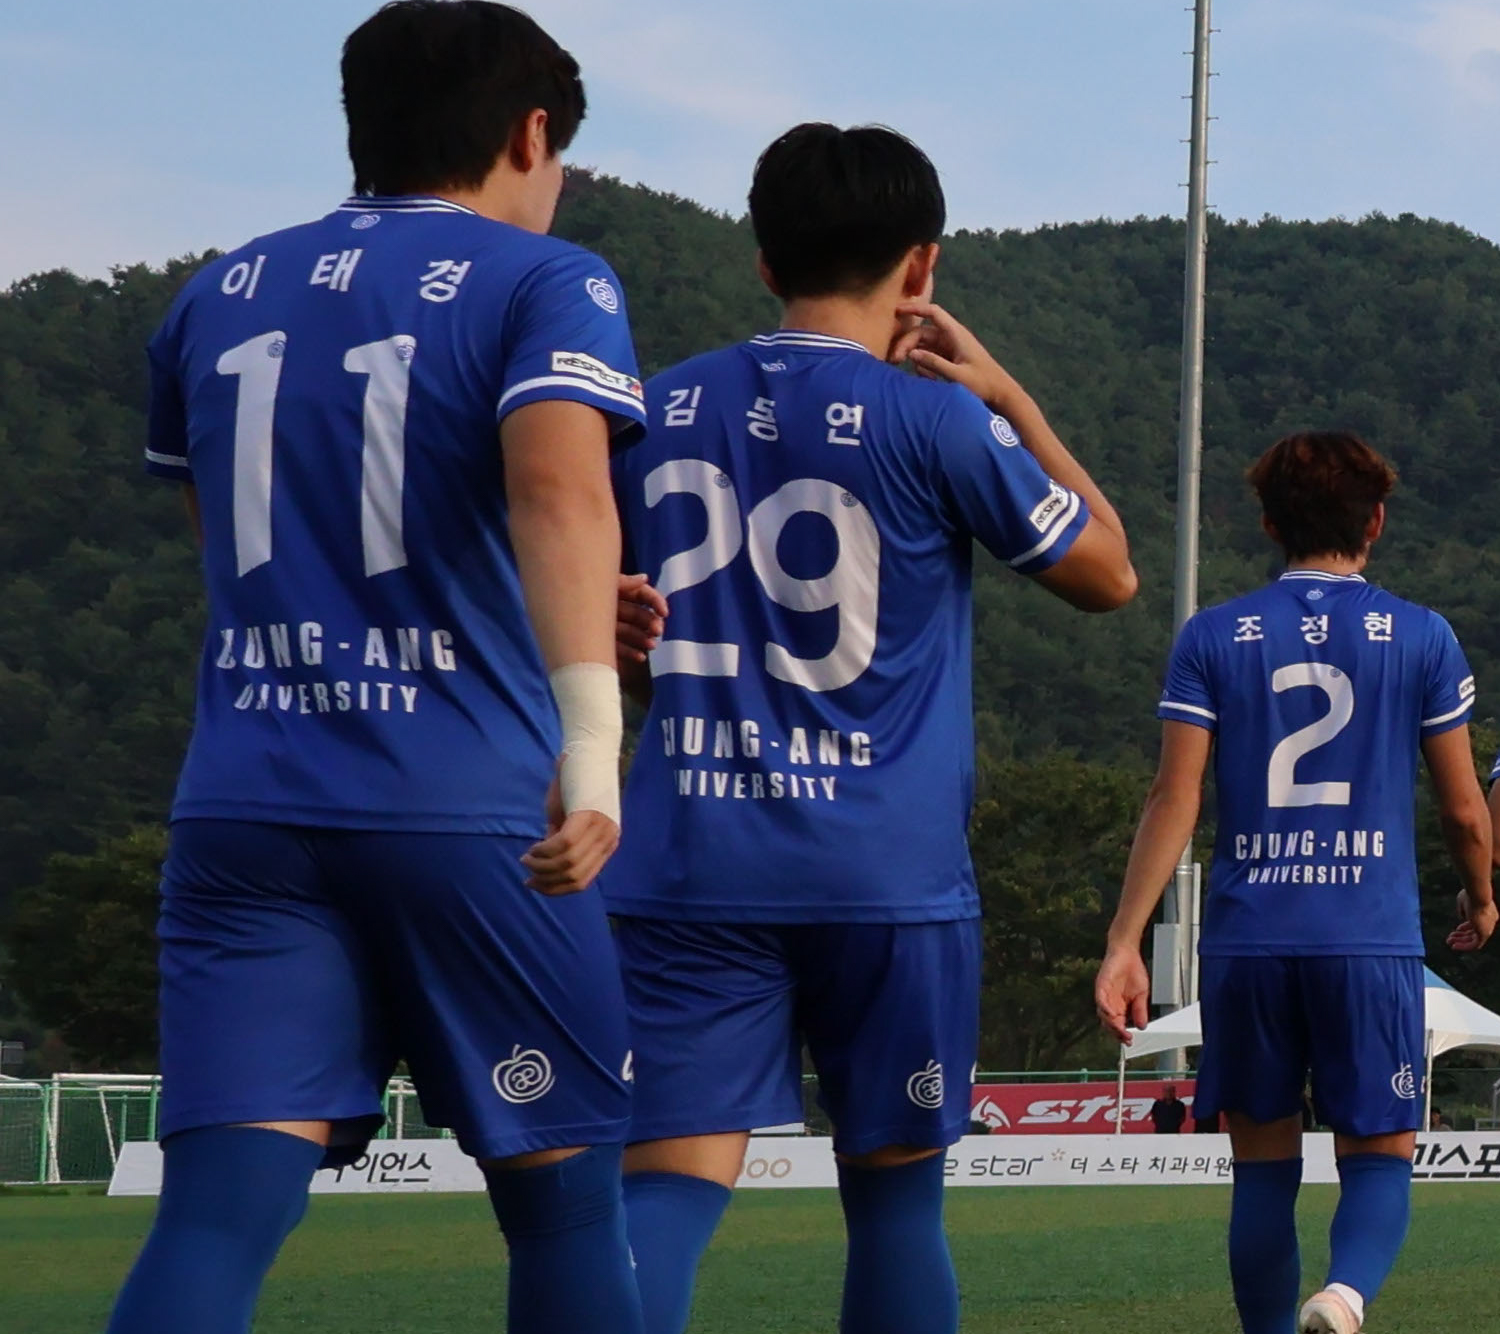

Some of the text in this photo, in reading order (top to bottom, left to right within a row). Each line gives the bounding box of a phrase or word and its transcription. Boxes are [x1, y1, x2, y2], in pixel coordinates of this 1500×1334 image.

[215, 330, 417, 578] 11
[644, 458, 881, 692] 29
[1233, 612, 1393, 644] 조정현
[1267, 661, 1354, 808] 2
[1236, 830, 1384, 860] CHUNG-ANG
[1248, 864, 1363, 884] UNIVERSITY
[969, 1154, 1044, 1177] star
[1070, 1155, 1235, 1177] 더 스타 치과의원
